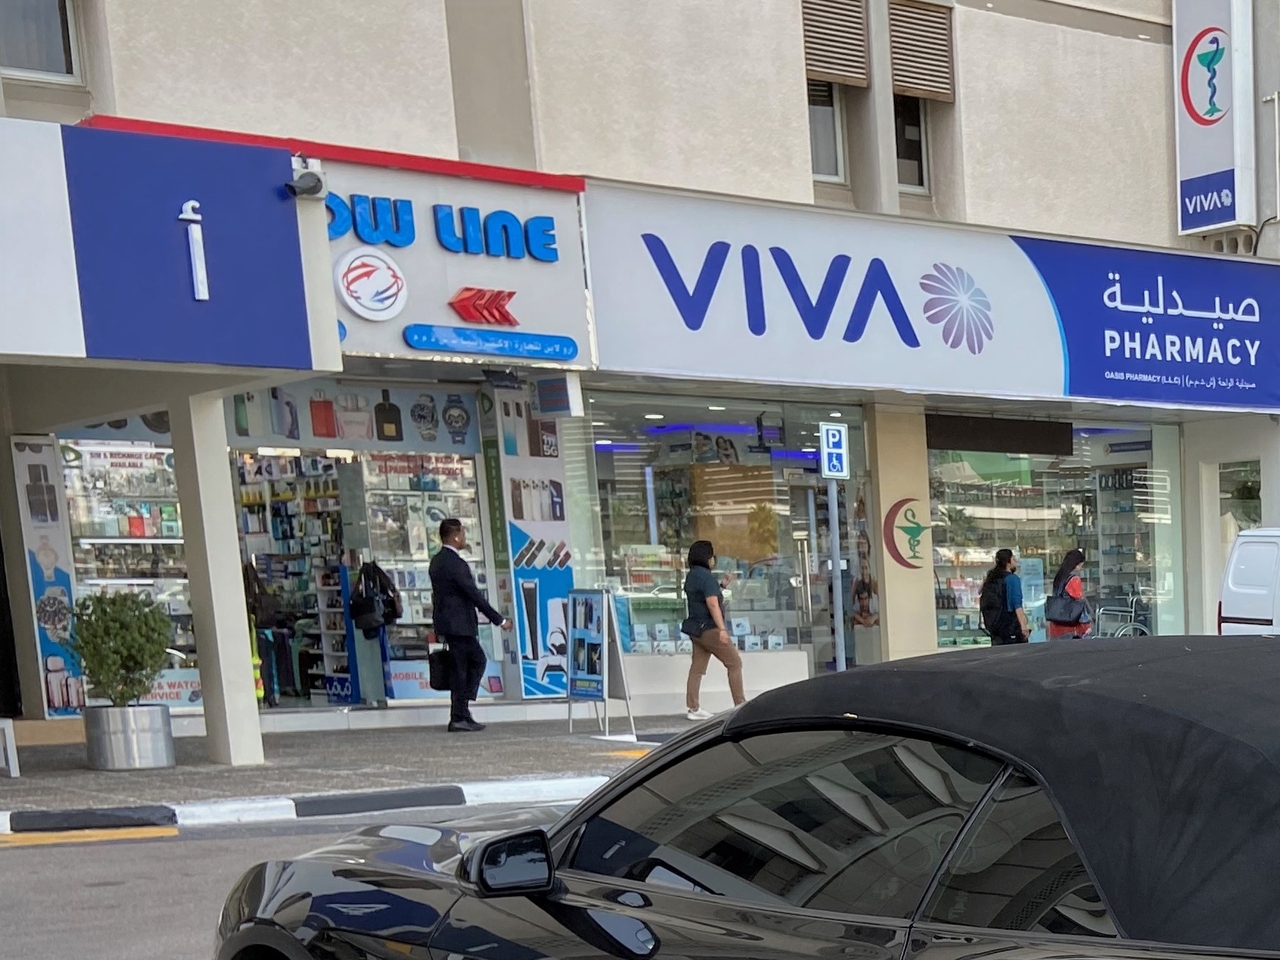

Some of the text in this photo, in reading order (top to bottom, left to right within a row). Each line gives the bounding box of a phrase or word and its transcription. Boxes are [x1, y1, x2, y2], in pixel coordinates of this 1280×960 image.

[1185, 191, 1221, 214] VIVA
[432, 204, 559, 263] LINE
[640, 233, 921, 348] VIVA
[1103, 272, 1260, 330] صيدلية
[1104, 329, 1261, 366] PHARMACY
[1105, 371, 1125, 380] OASIS
[1126, 372, 1161, 383] PHARMACY
[828, 430, 840, 448] P
